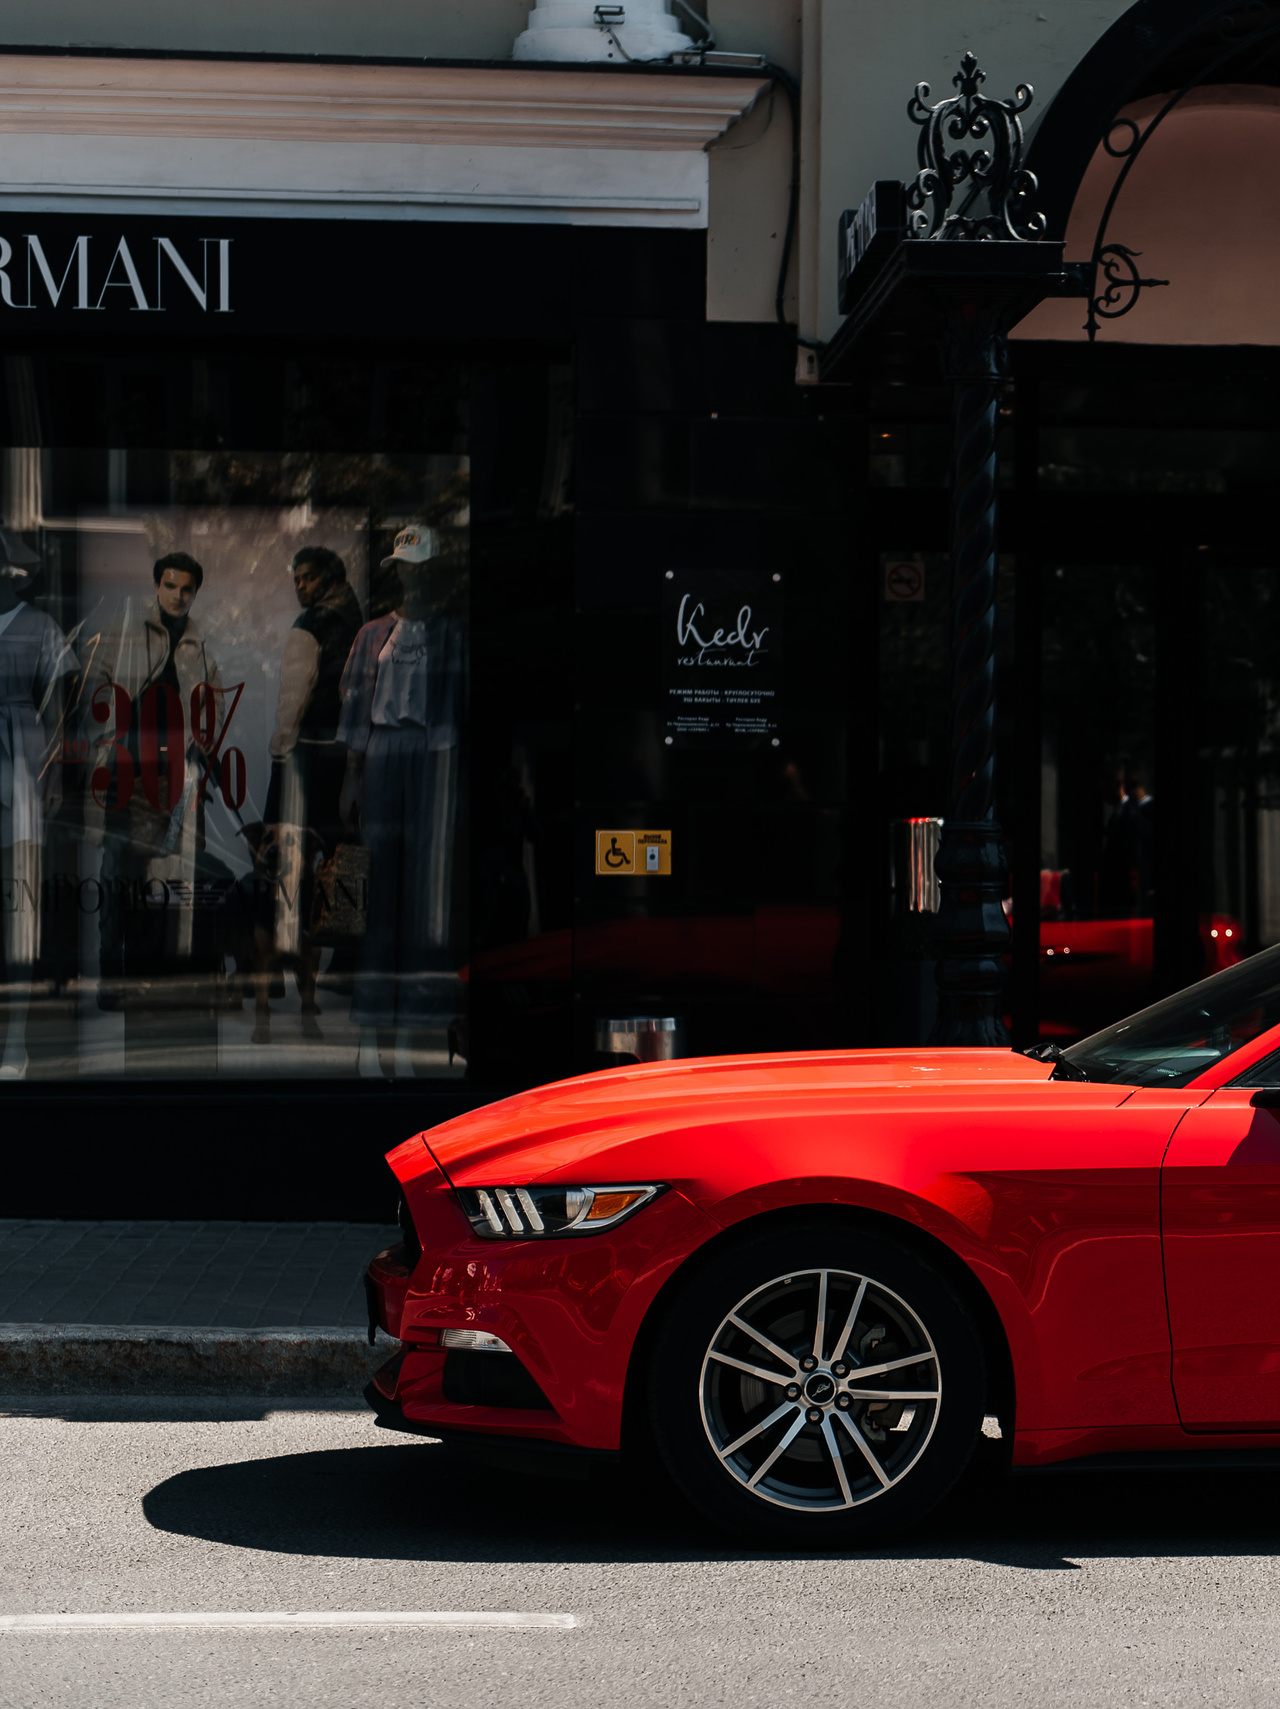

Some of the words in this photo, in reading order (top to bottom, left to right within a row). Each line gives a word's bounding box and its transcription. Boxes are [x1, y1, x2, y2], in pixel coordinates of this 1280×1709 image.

[676, 593, 770, 649] Kedr
[676, 648, 769, 668] restaurant
[694, 688, 720, 696] РАБОТЫ
[91, 680, 247, 813] 30%
